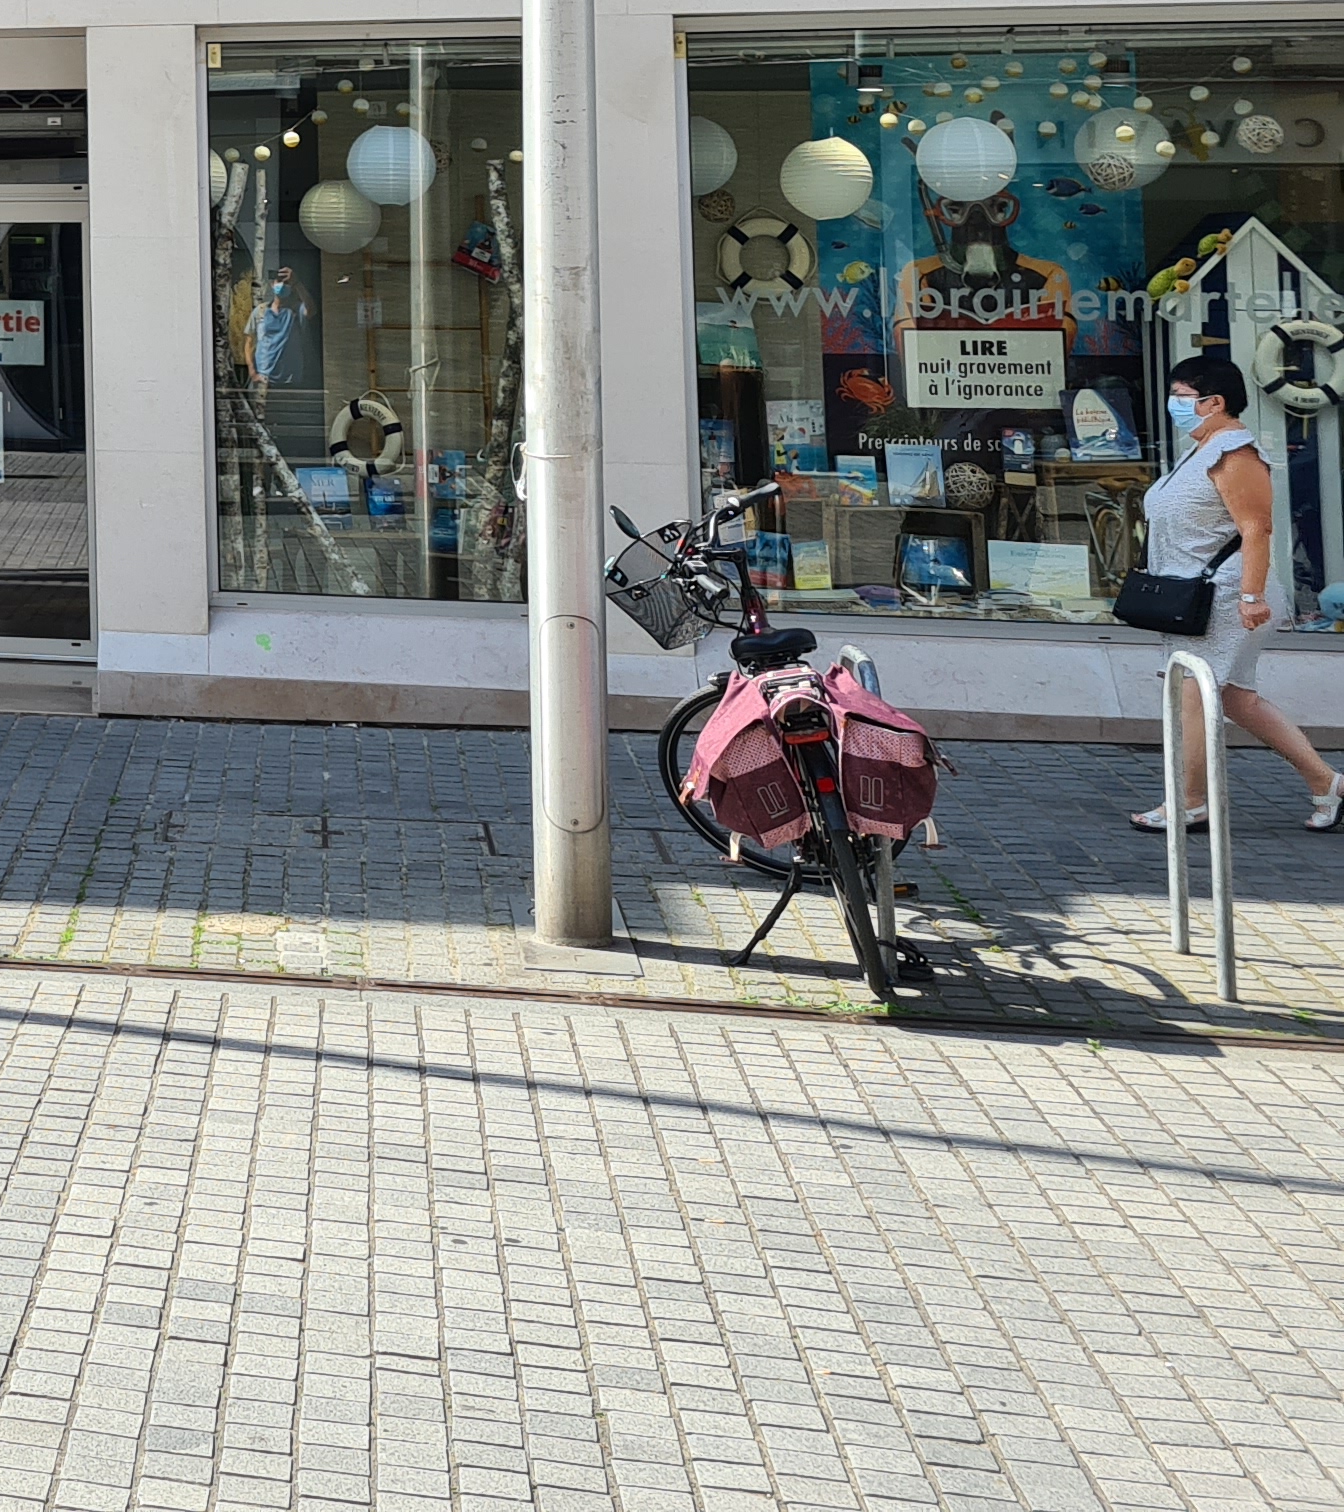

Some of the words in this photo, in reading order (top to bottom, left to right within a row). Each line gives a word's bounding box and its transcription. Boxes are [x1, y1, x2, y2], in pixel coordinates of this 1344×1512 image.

[960, 339, 1008, 356] LIRE
[918, 357, 952, 375] nuit
[958, 360, 1052, 379] gravement
[929, 379, 939, 396] à
[945, 377, 1044, 400] l'ignorance
[964, 432, 981, 452] de
